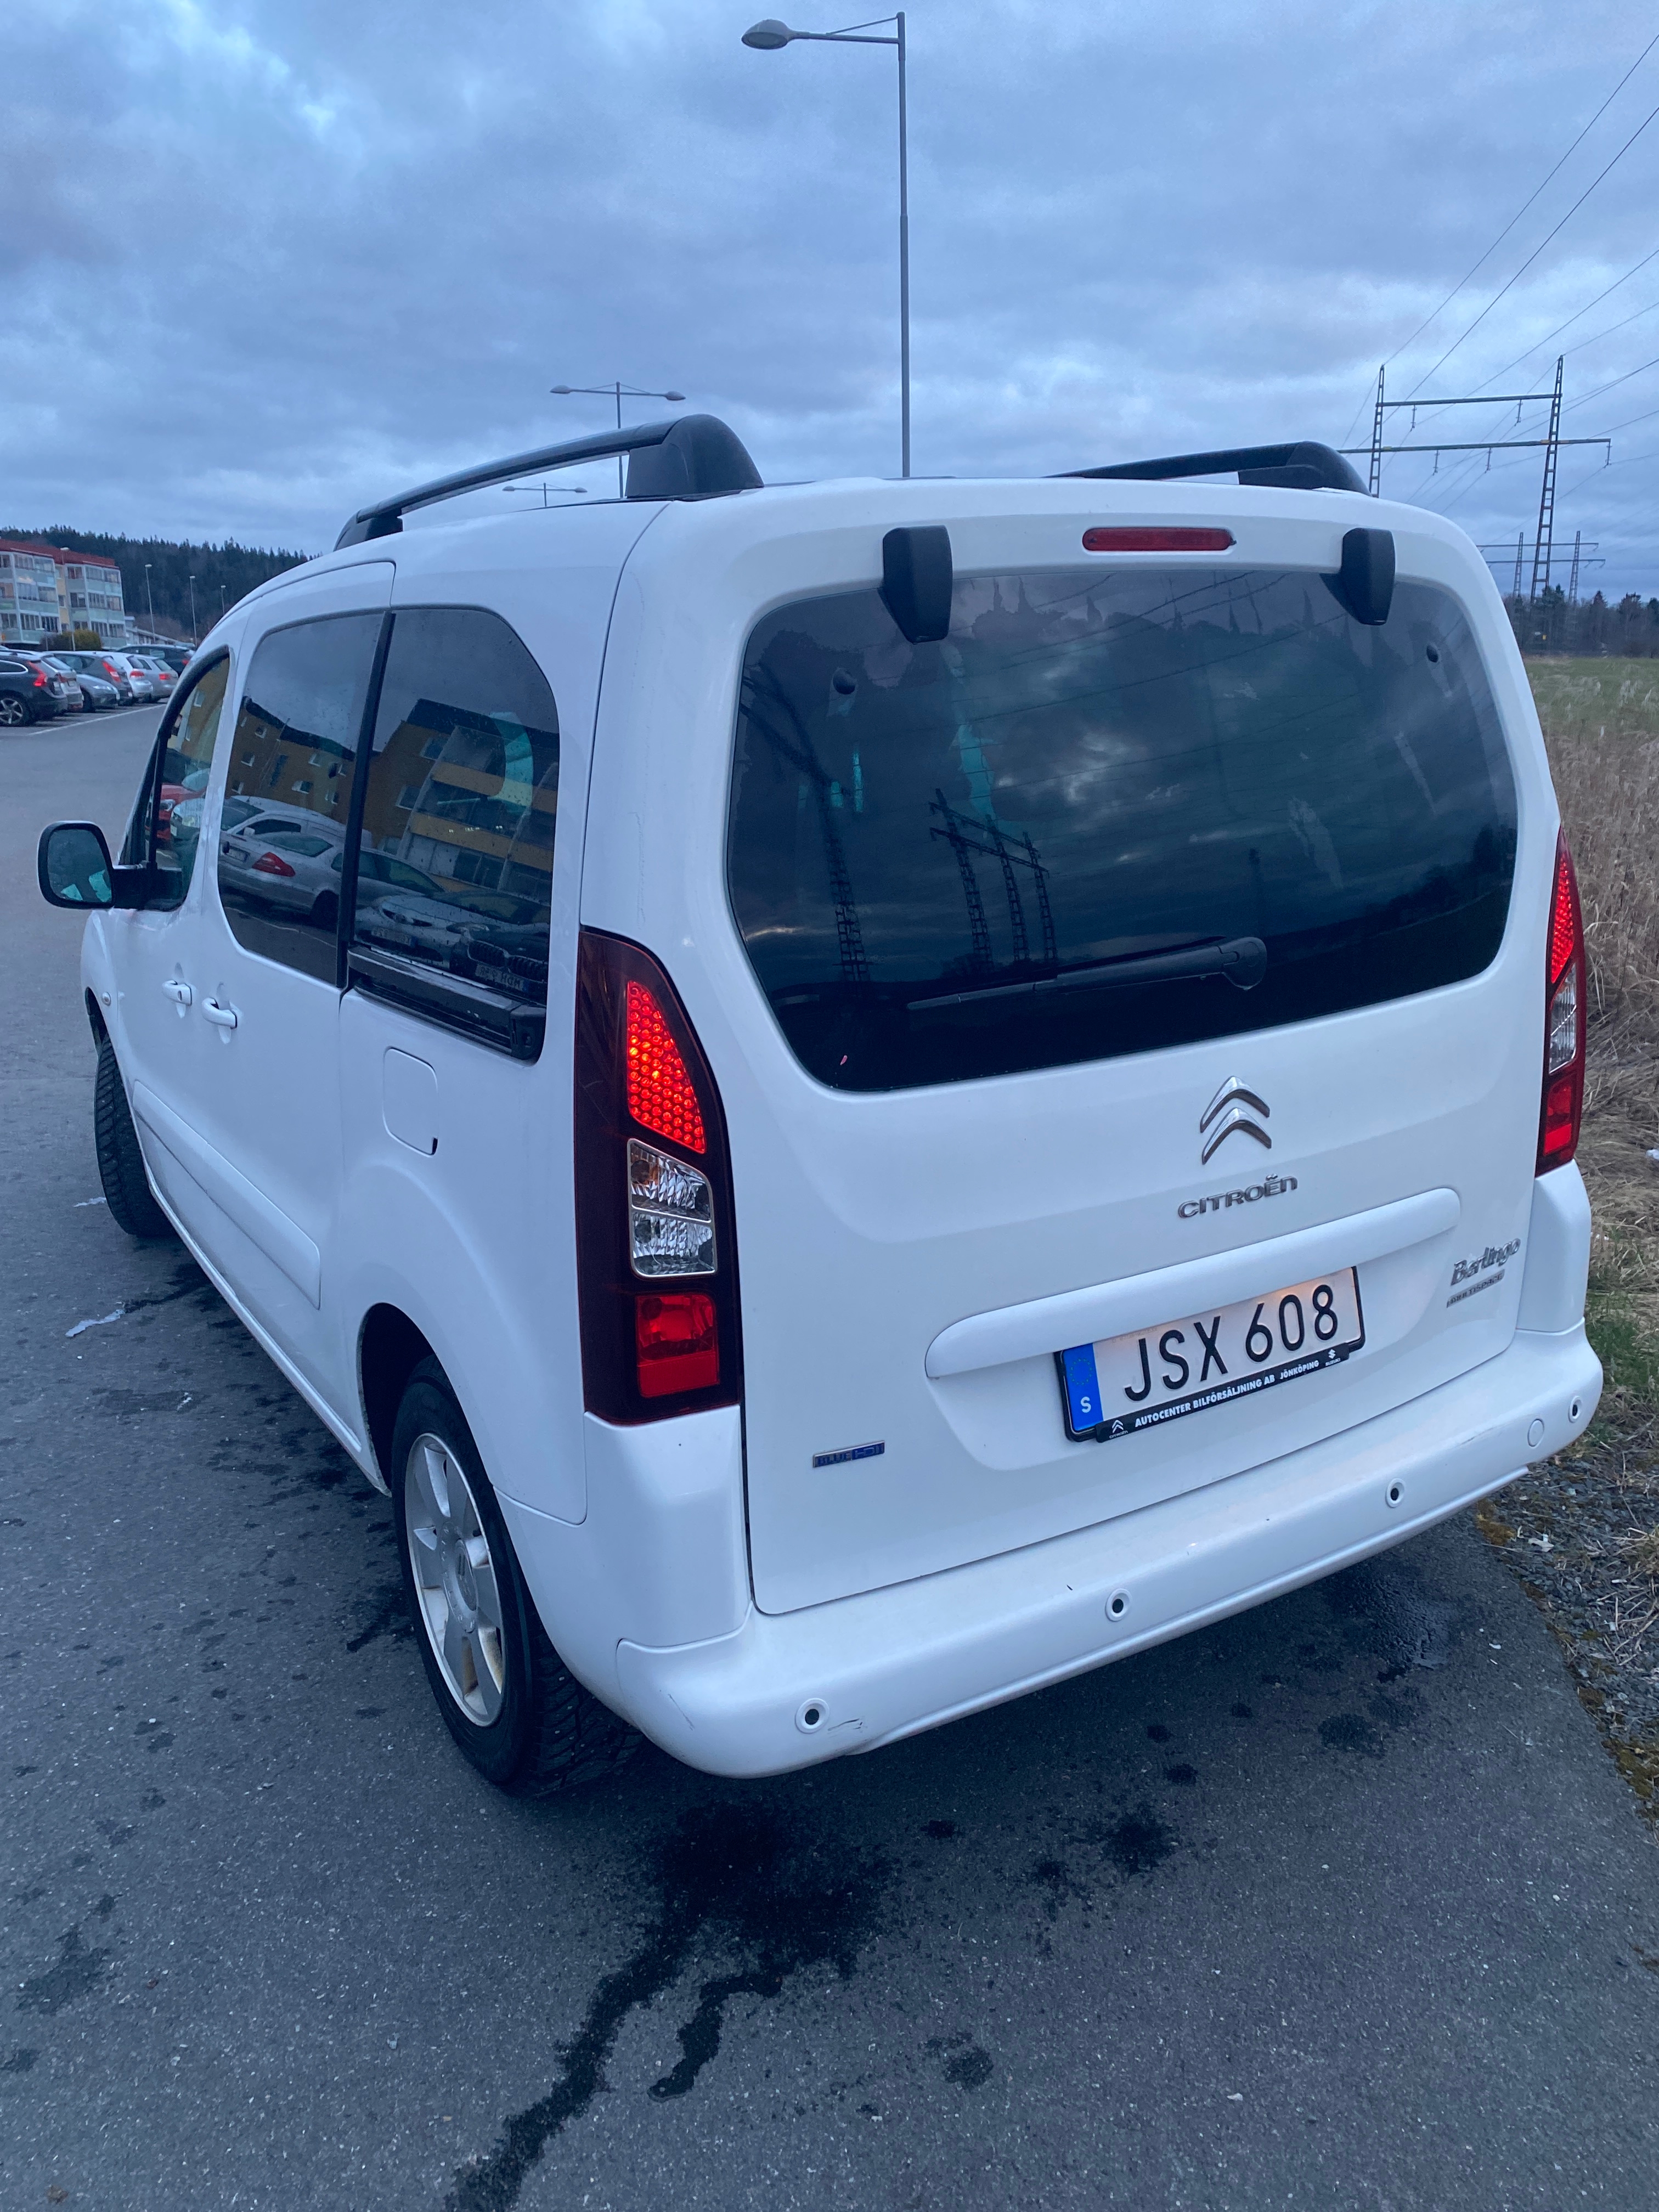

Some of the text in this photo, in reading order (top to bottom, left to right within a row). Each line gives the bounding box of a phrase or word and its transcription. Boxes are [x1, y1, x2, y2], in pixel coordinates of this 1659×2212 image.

[1178, 1173, 1297, 1218] CITROËN
[1451, 1238, 1521, 1286] Berlingo
[1125, 1284, 1339, 1402] JSX 608
[1080, 1396, 1092, 1414] S
[1135, 1360, 1319, 1427] AUTOCENTER BILFÖRSÄLJNING AB JÖNKÖPING
